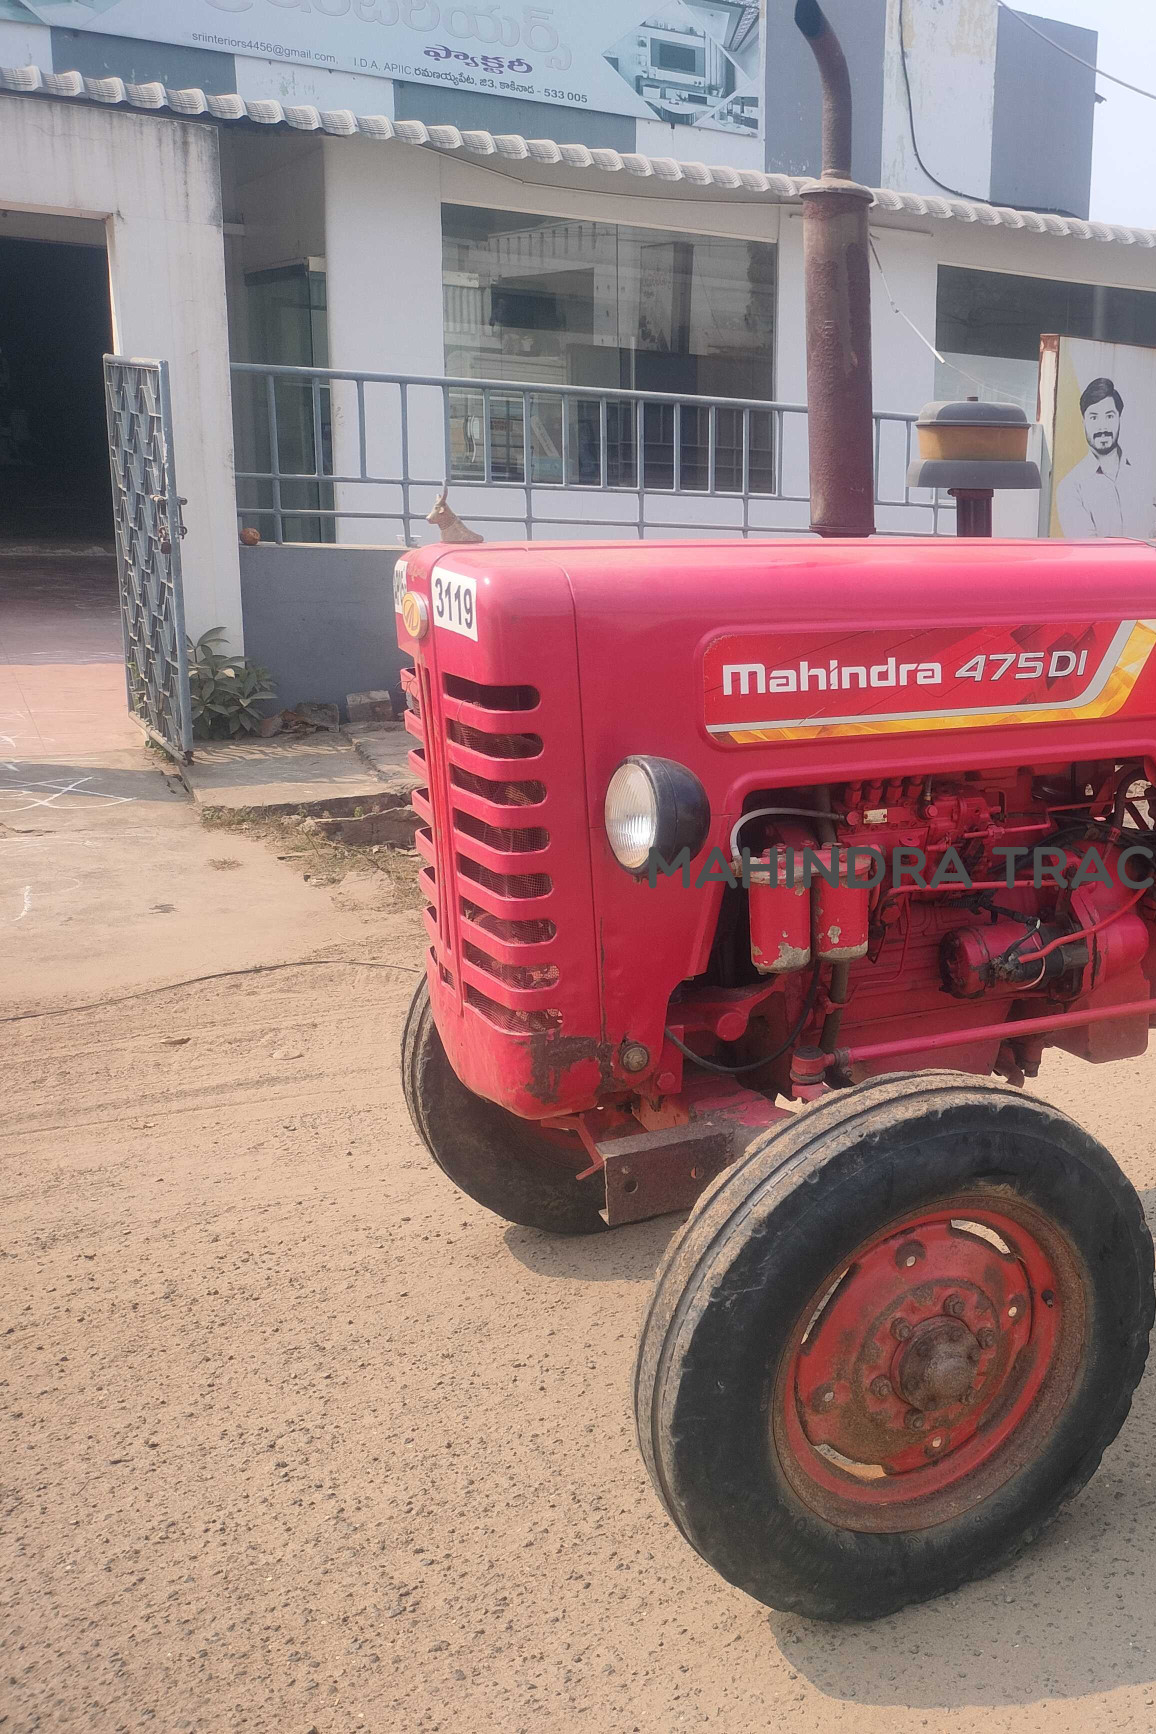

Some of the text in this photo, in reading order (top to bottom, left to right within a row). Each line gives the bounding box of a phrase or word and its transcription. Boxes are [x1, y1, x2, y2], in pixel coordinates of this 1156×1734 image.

[544, 88, 564, 100] 533
[567, 91, 588, 103] 005
[435, 577, 473, 630] 3119
[723, 657, 942, 696] Mahindra
